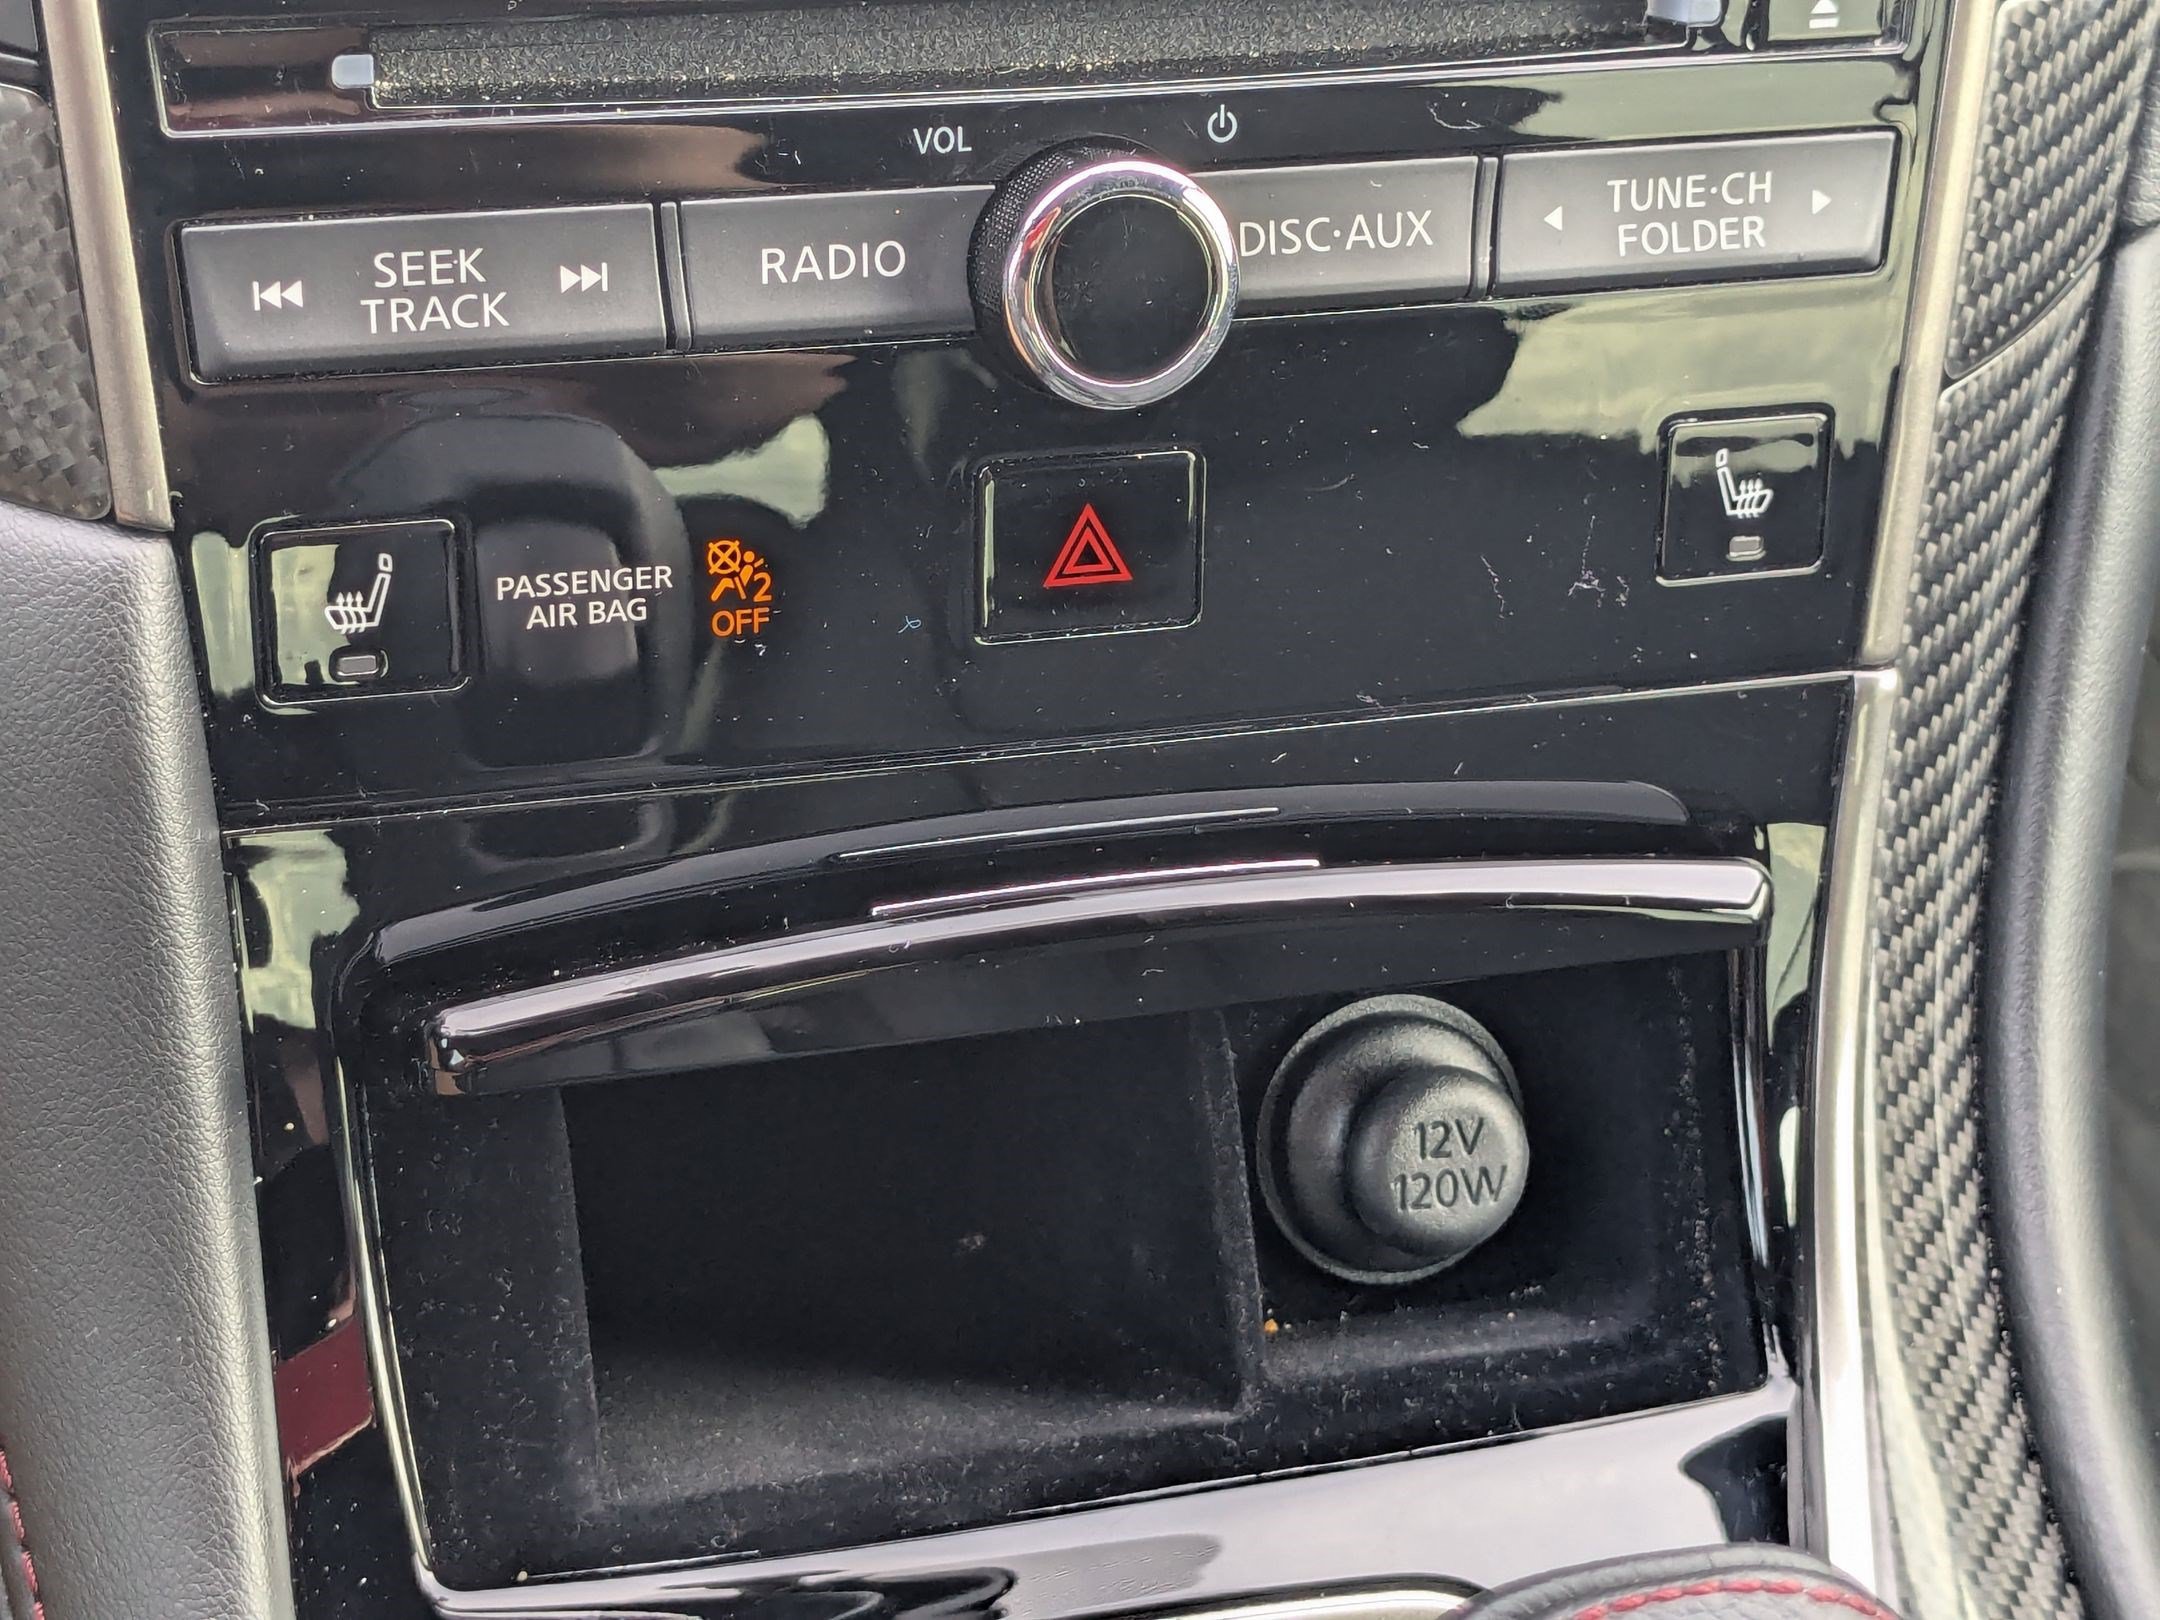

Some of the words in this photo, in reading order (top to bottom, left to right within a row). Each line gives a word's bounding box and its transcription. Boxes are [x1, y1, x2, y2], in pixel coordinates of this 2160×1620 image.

[913, 126, 973, 155] VOL
[1617, 214, 1766, 257] FOLDER
[373, 247, 488, 289] SEEK
[760, 240, 906, 285] RADIO
[360, 291, 510, 335] TRACK
[496, 564, 673, 601] PASSENGER
[526, 603, 579, 631] AIR
[588, 598, 648, 625] BAG
[711, 607, 770, 637] OFF
[1413, 1117, 1486, 1160] 12V
[1394, 1164, 1508, 1211] 120W
